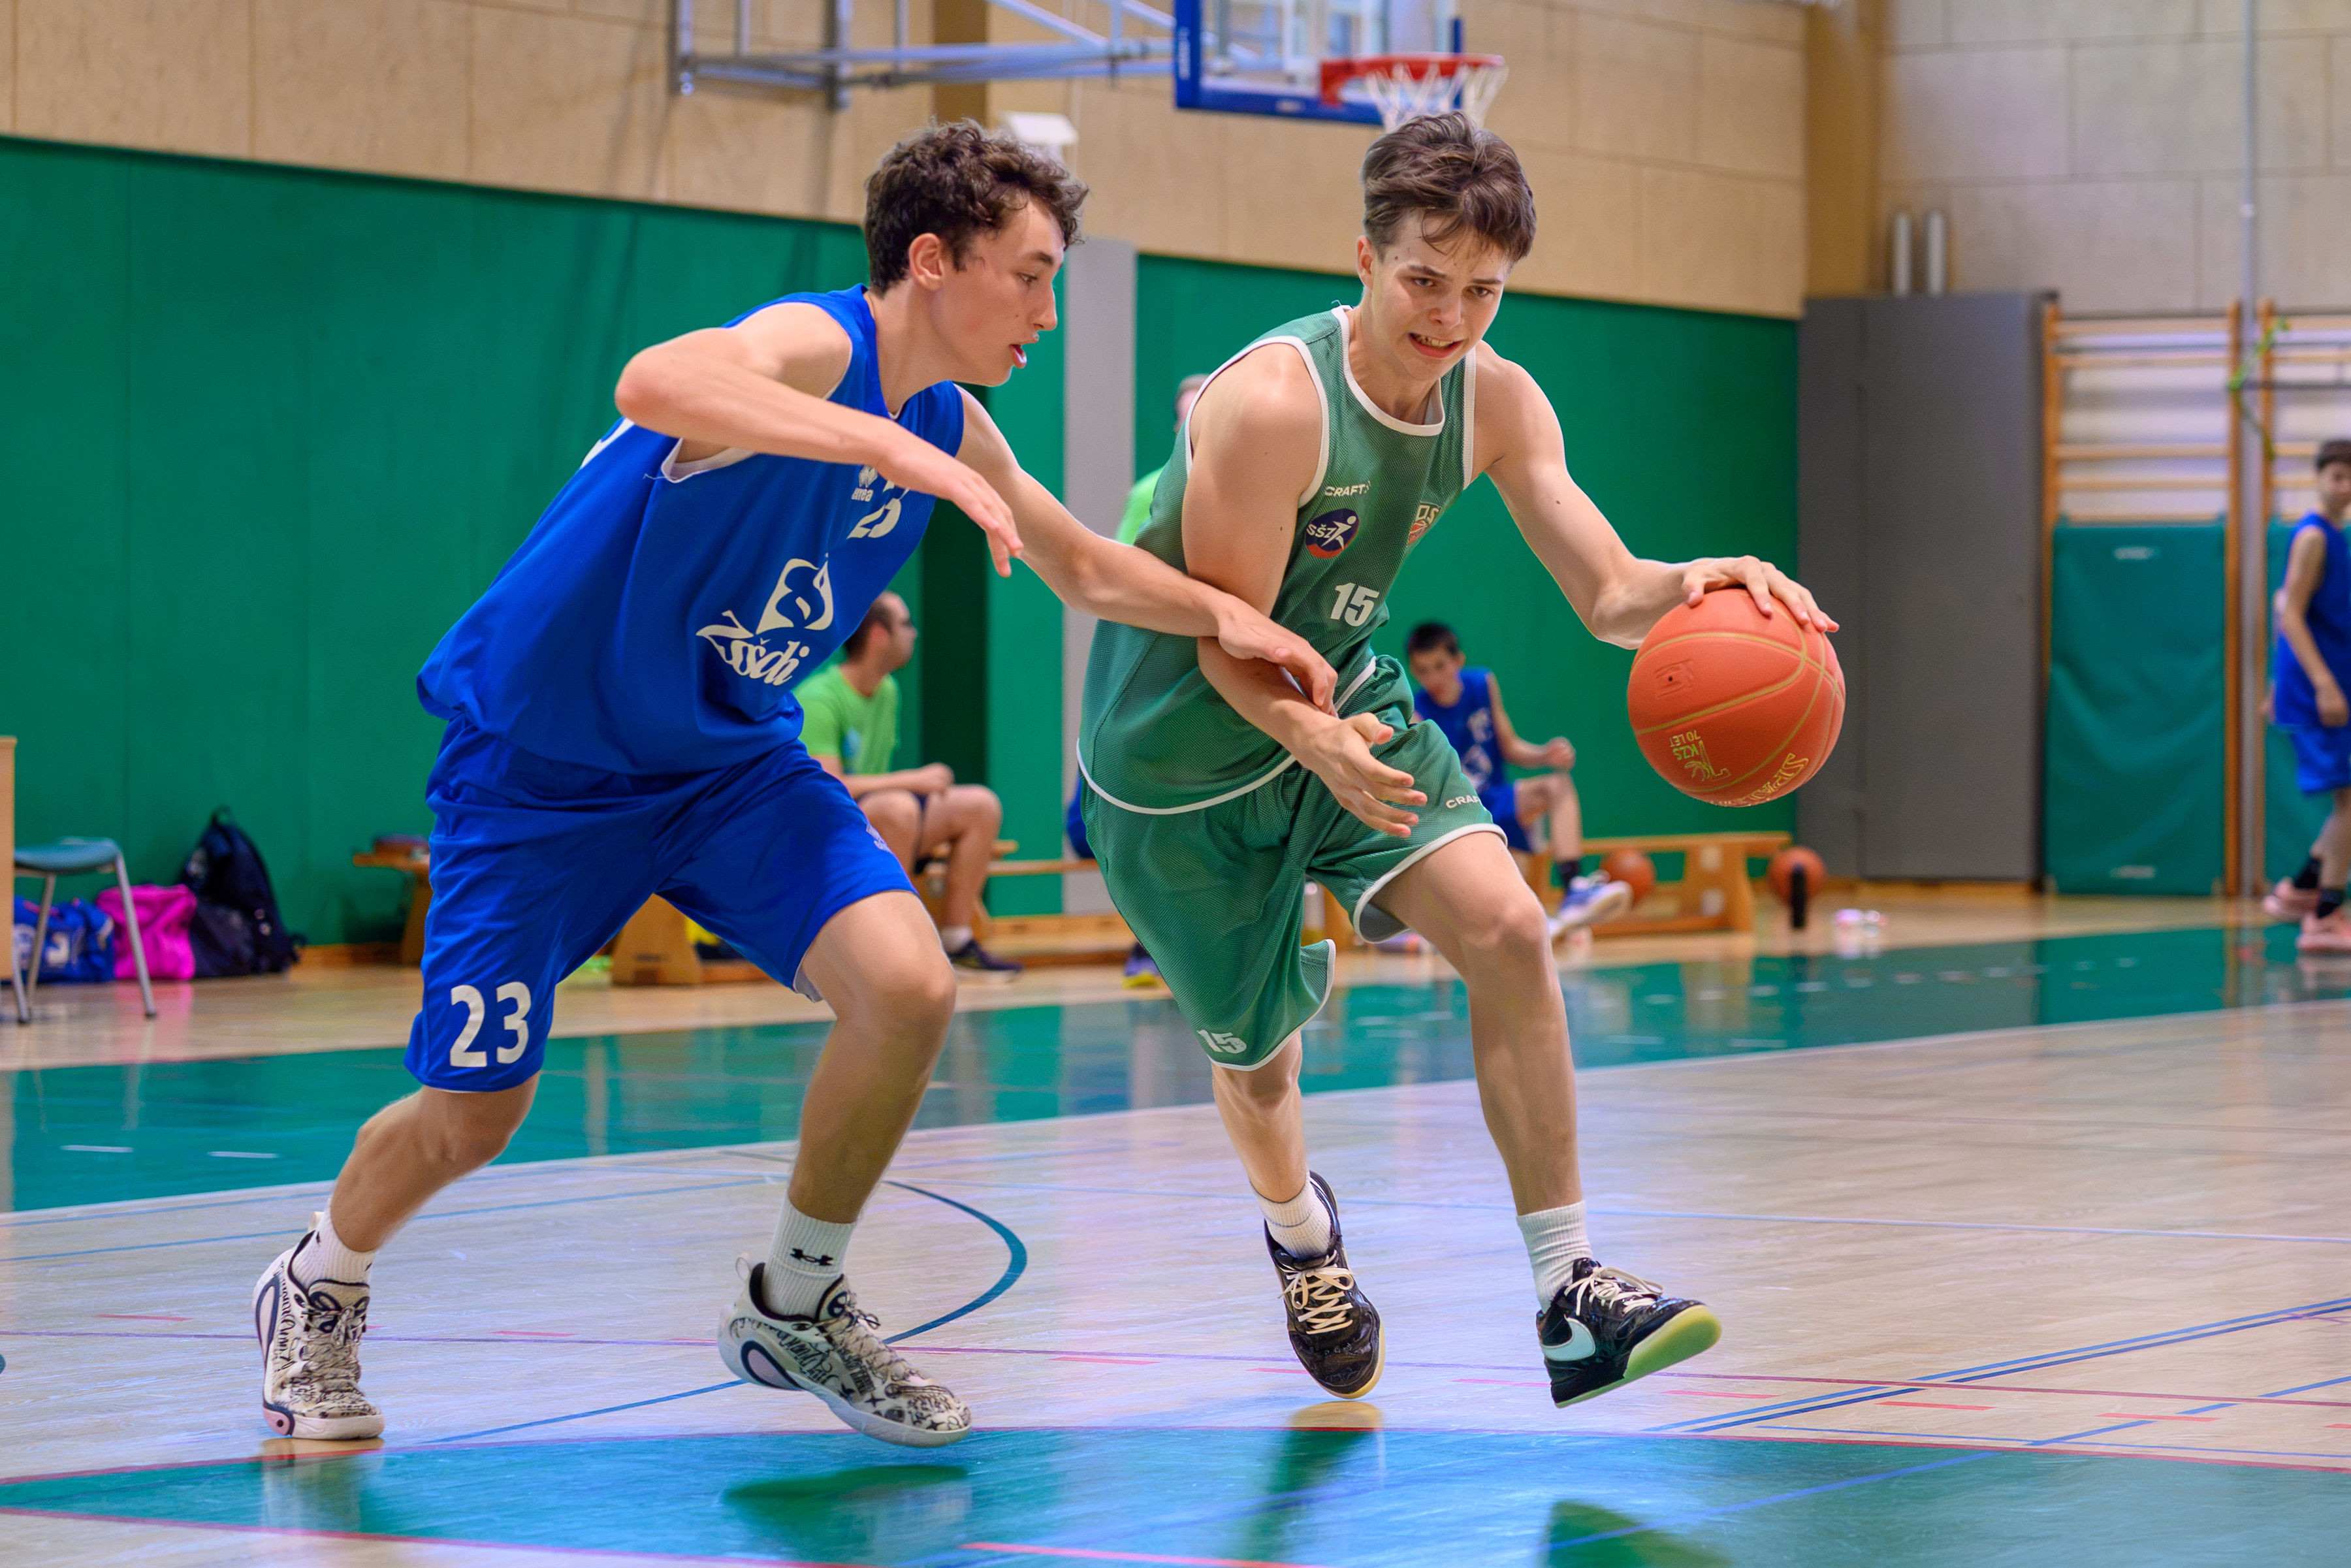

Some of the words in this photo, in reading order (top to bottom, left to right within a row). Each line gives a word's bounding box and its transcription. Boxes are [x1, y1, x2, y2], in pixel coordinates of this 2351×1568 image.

[1324, 483, 1366, 496] CRAFT
[1330, 582, 1380, 627] 15
[1669, 733, 1686, 748] LET
[1686, 729, 1701, 742] 70
[1672, 743, 1699, 761] KZS
[449, 981, 532, 1068] 23
[1196, 1029, 1247, 1054] 15
